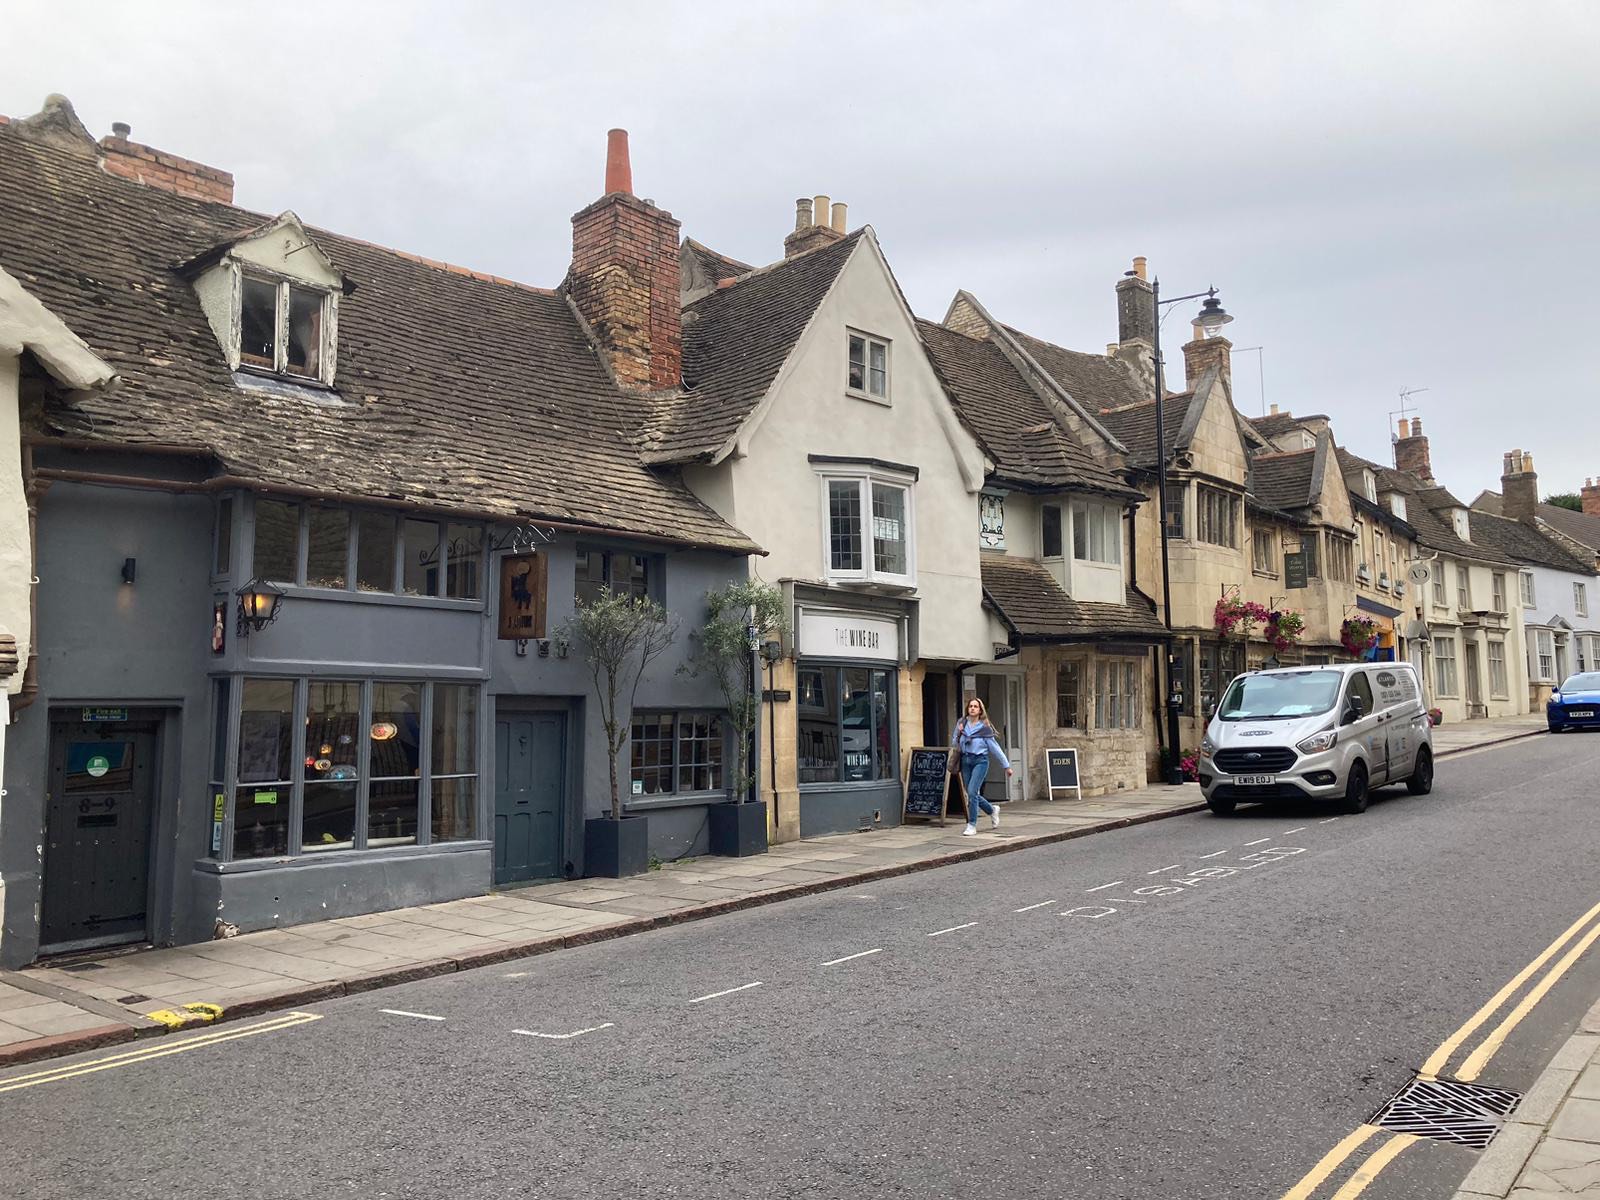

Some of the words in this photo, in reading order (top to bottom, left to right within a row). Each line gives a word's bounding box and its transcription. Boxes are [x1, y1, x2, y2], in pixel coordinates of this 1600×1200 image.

[834, 628, 848, 647] THE
[849, 629, 866, 647] WINE
[868, 631, 879, 649] BAR
[846, 755, 859, 766] WINE
[860, 755, 869, 766] BAR
[1053, 758, 1071, 766] EDEN
[1238, 776, 1254, 784] EW19
[1255, 776, 1271, 784] EOJ
[79, 796, 116, 814] 8-9
[1056, 846, 1308, 918] DISABLED
